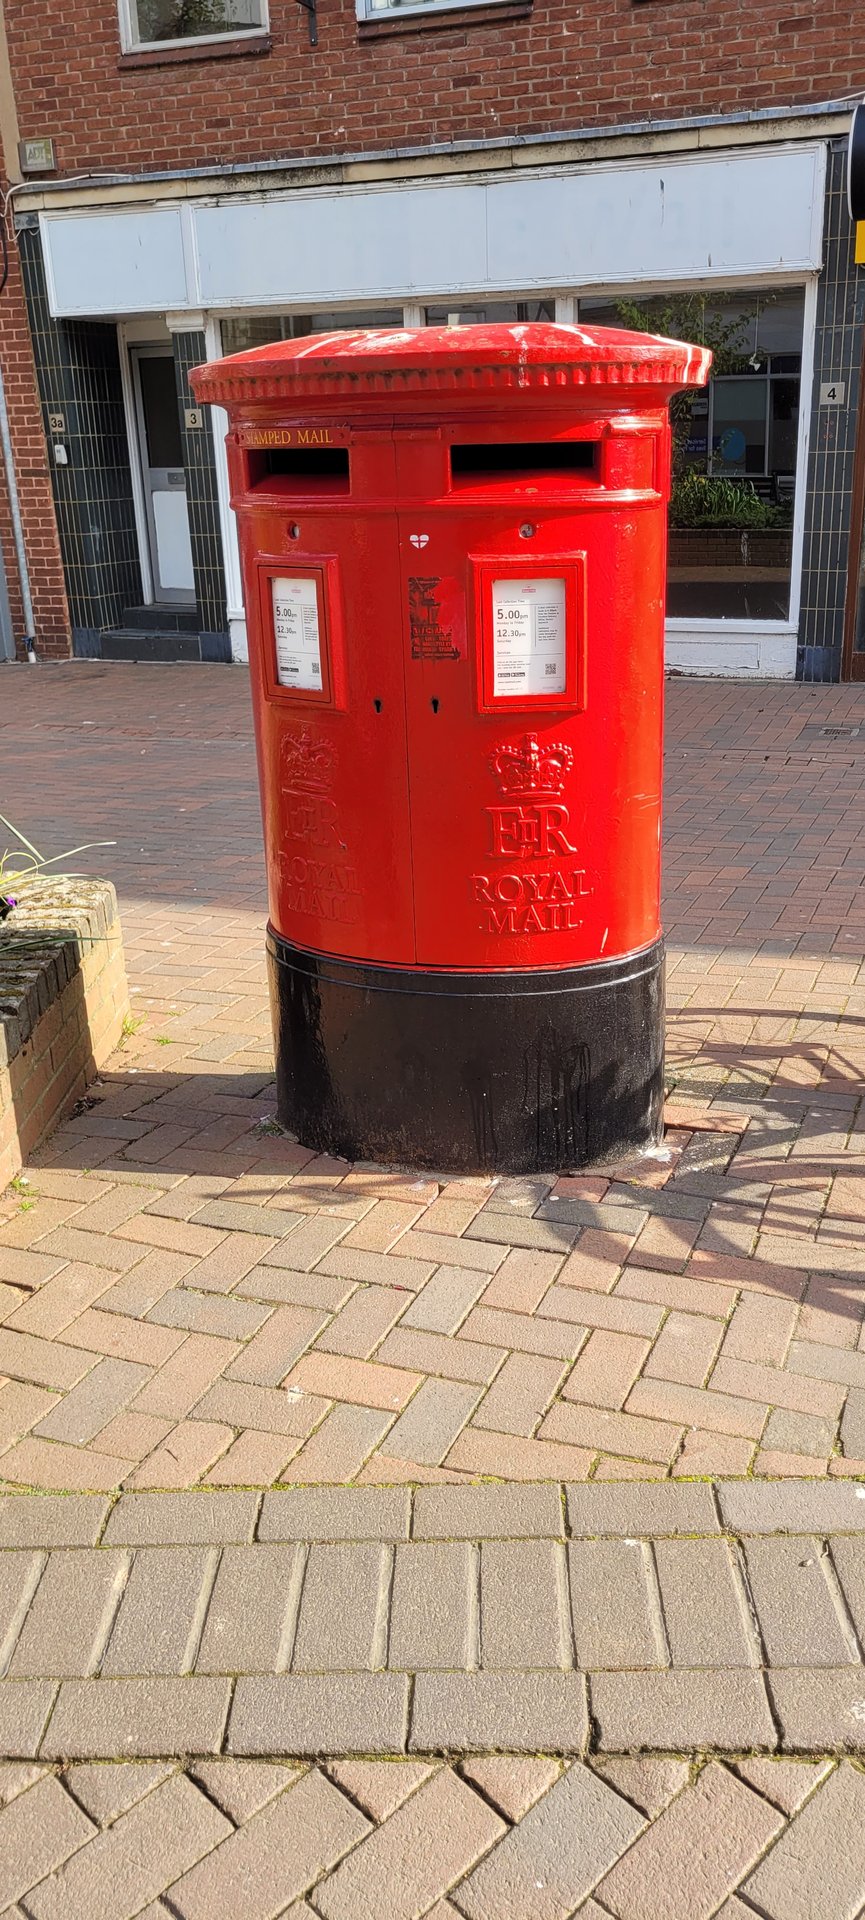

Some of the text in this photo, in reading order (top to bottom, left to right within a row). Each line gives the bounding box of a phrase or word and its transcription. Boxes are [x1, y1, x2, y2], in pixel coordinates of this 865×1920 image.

[827, 387, 837, 400] 4
[51, 417, 63, 428] 3a
[190, 413, 197, 424] 3
[246, 429, 334, 445] STAMPED MAIL
[276, 606, 297, 618] 5.00pm
[497, 608, 528, 620] 5.00pm
[277, 625, 296, 634] 12.30pm
[497, 629, 526, 638] 12.30pm
[278, 850, 365, 896] ROYAL
[470, 869, 594, 902] ROYAL
[479, 902, 584, 933] MAIL
